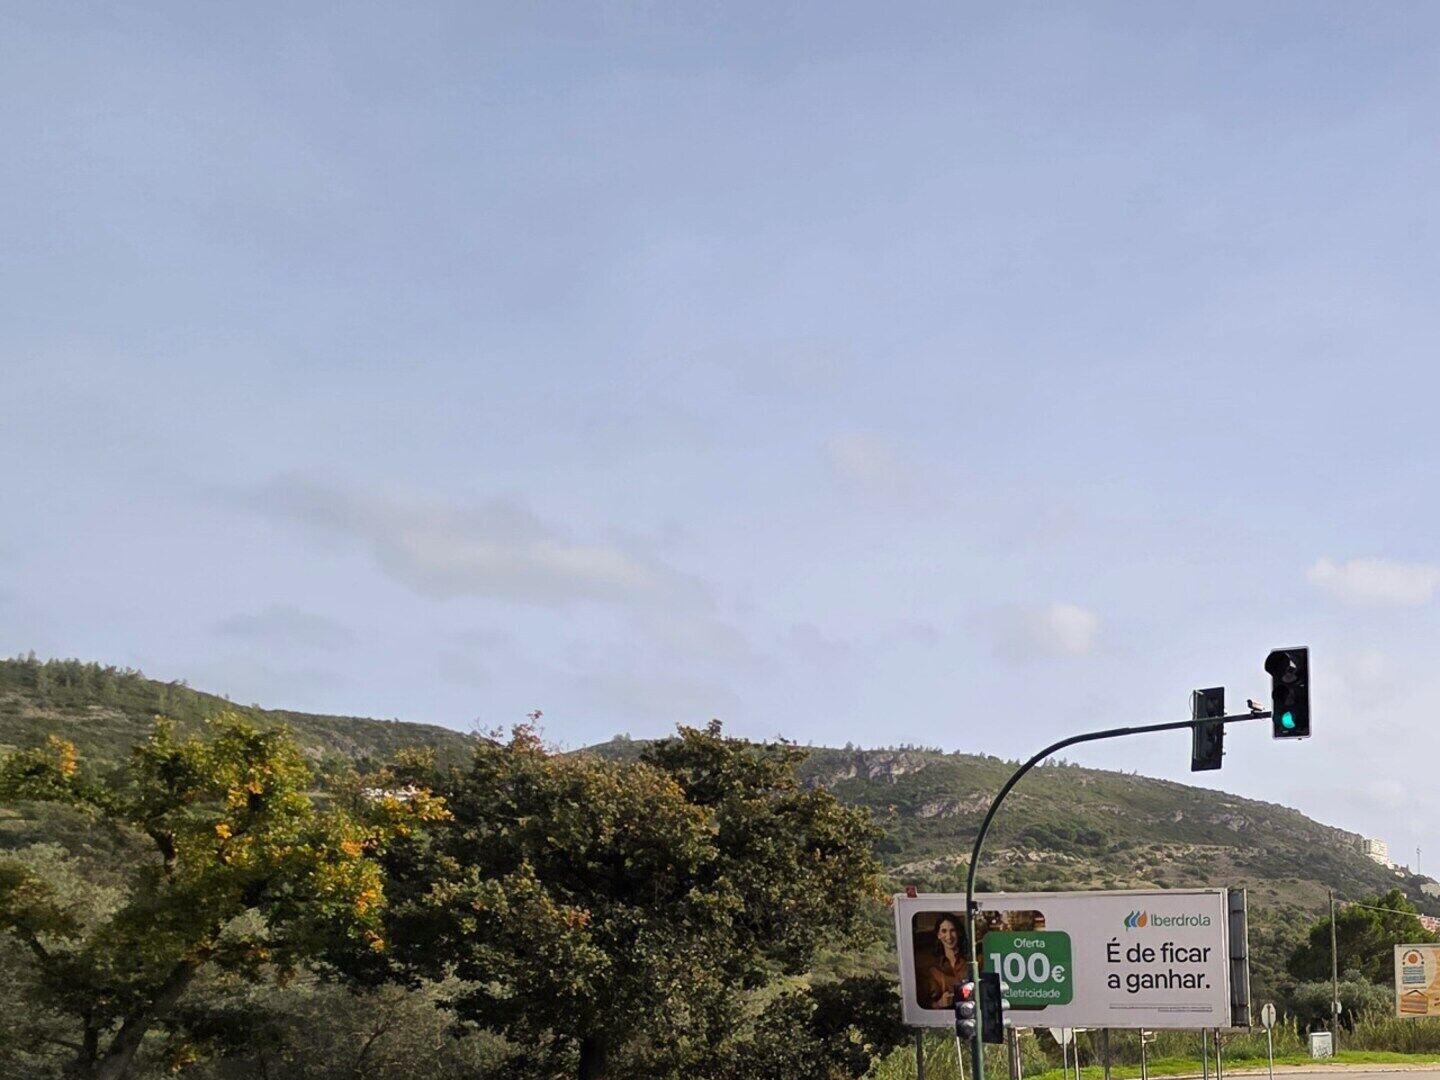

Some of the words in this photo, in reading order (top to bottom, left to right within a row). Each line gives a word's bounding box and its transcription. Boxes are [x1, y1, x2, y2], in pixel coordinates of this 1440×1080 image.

[1150, 913, 1211, 927] Iberdrola
[1013, 937, 1046, 949] Oferta
[1106, 937, 1121, 963] É
[1126, 943, 1156, 963] de
[1160, 942, 1211, 963] ficar
[1107, 973, 1121, 989] a
[1126, 969, 1211, 994] ganhar.
